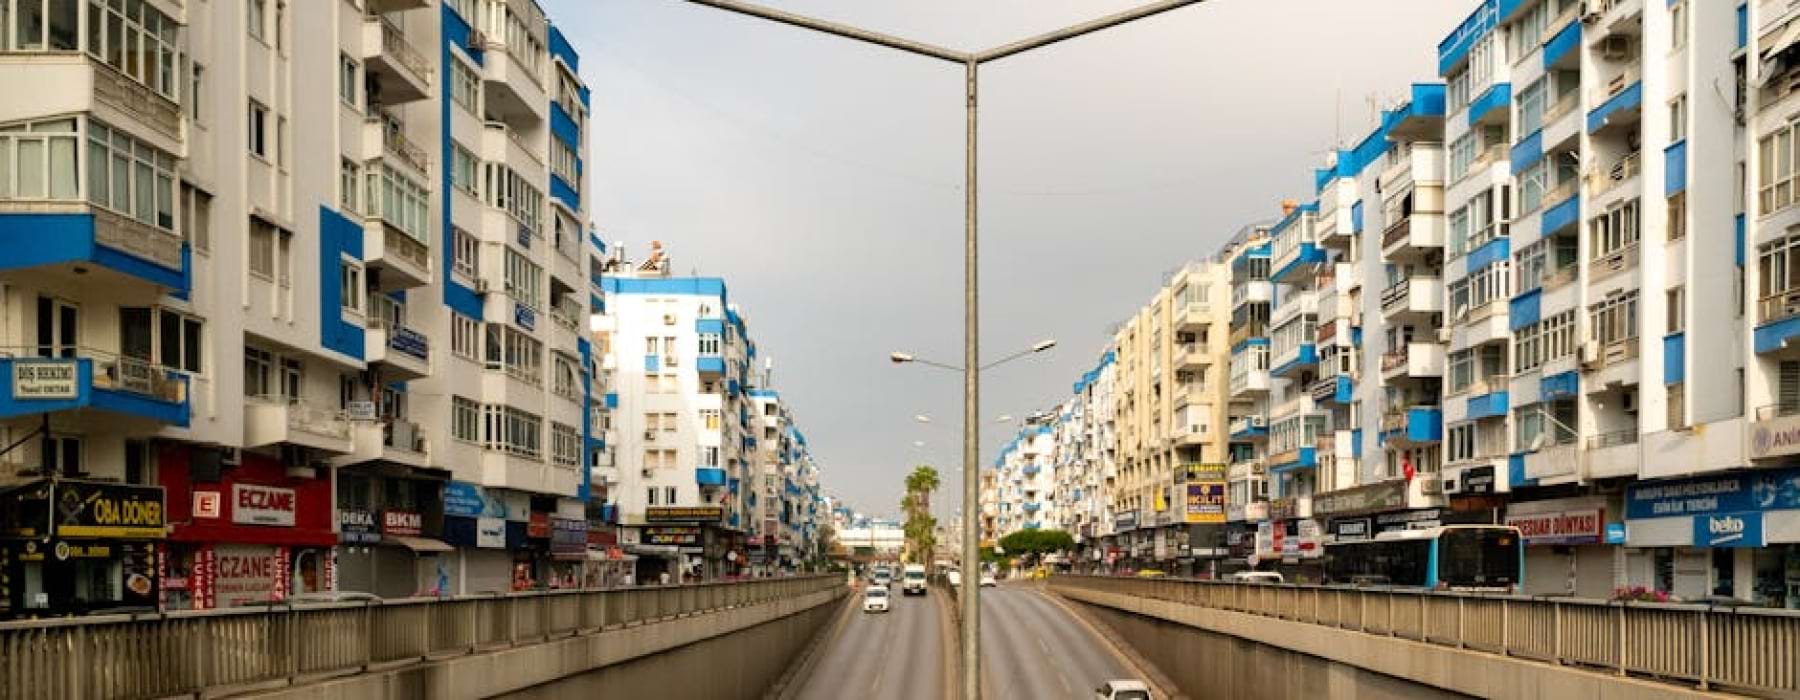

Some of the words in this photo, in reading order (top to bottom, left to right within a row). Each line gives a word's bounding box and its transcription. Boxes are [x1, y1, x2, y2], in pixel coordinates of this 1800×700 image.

[1773, 425, 1800, 447] ANİ
[95, 498, 120, 525] OBA
[122, 495, 162, 525] DÖNER
[200, 496, 212, 512] E
[239, 487, 294, 512] ECZANE
[342, 511, 375, 525] DEKA
[386, 511, 422, 529] BKM
[1553, 512, 1595, 535] DÜNYASI
[1710, 515, 1744, 533] beko
[215, 555, 271, 579] CZANE
[195, 551, 204, 608] ECZAN
